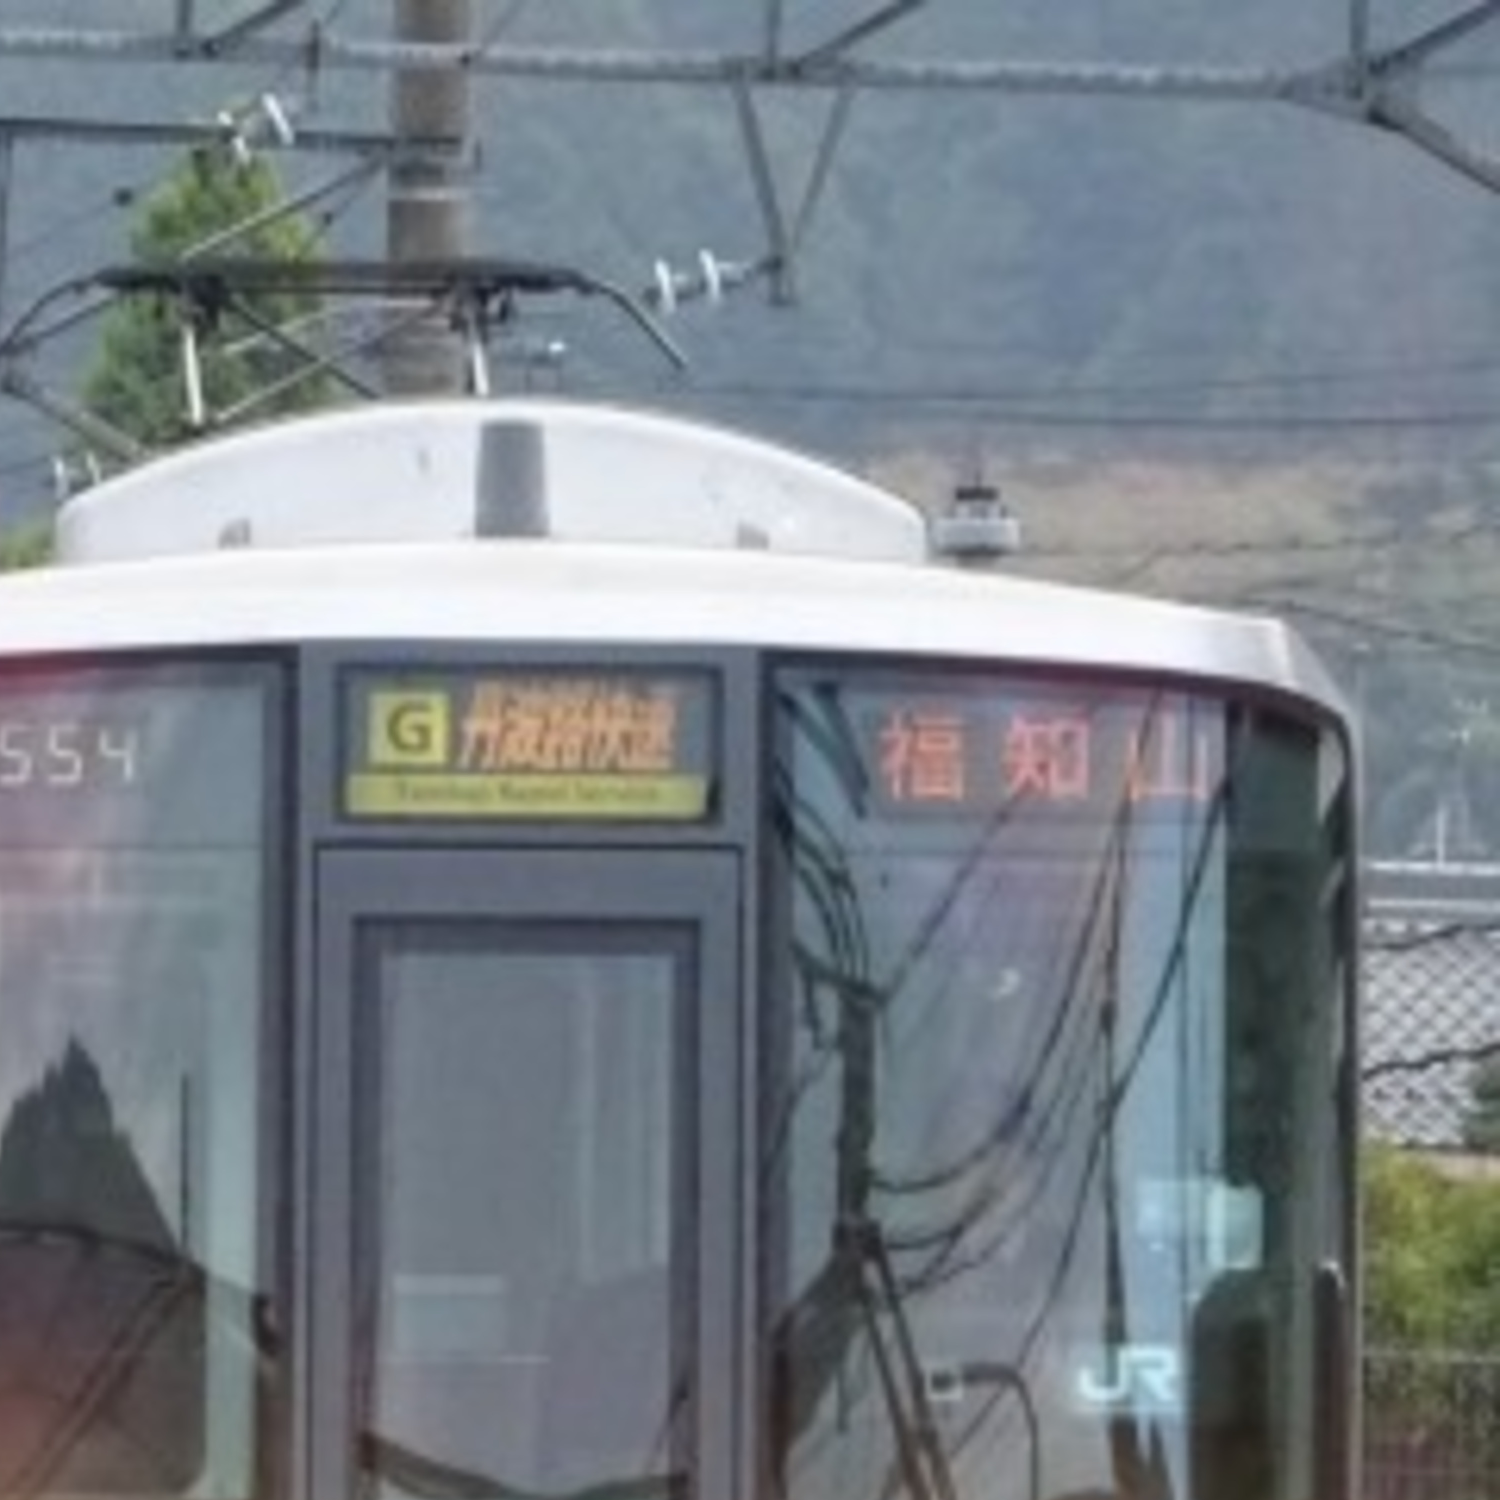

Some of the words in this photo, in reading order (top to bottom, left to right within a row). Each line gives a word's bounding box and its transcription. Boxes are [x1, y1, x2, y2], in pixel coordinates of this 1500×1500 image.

[387, 702, 432, 752] G
[880, 708, 1208, 802] 福知山
[1079, 1346, 1180, 1402] JR
